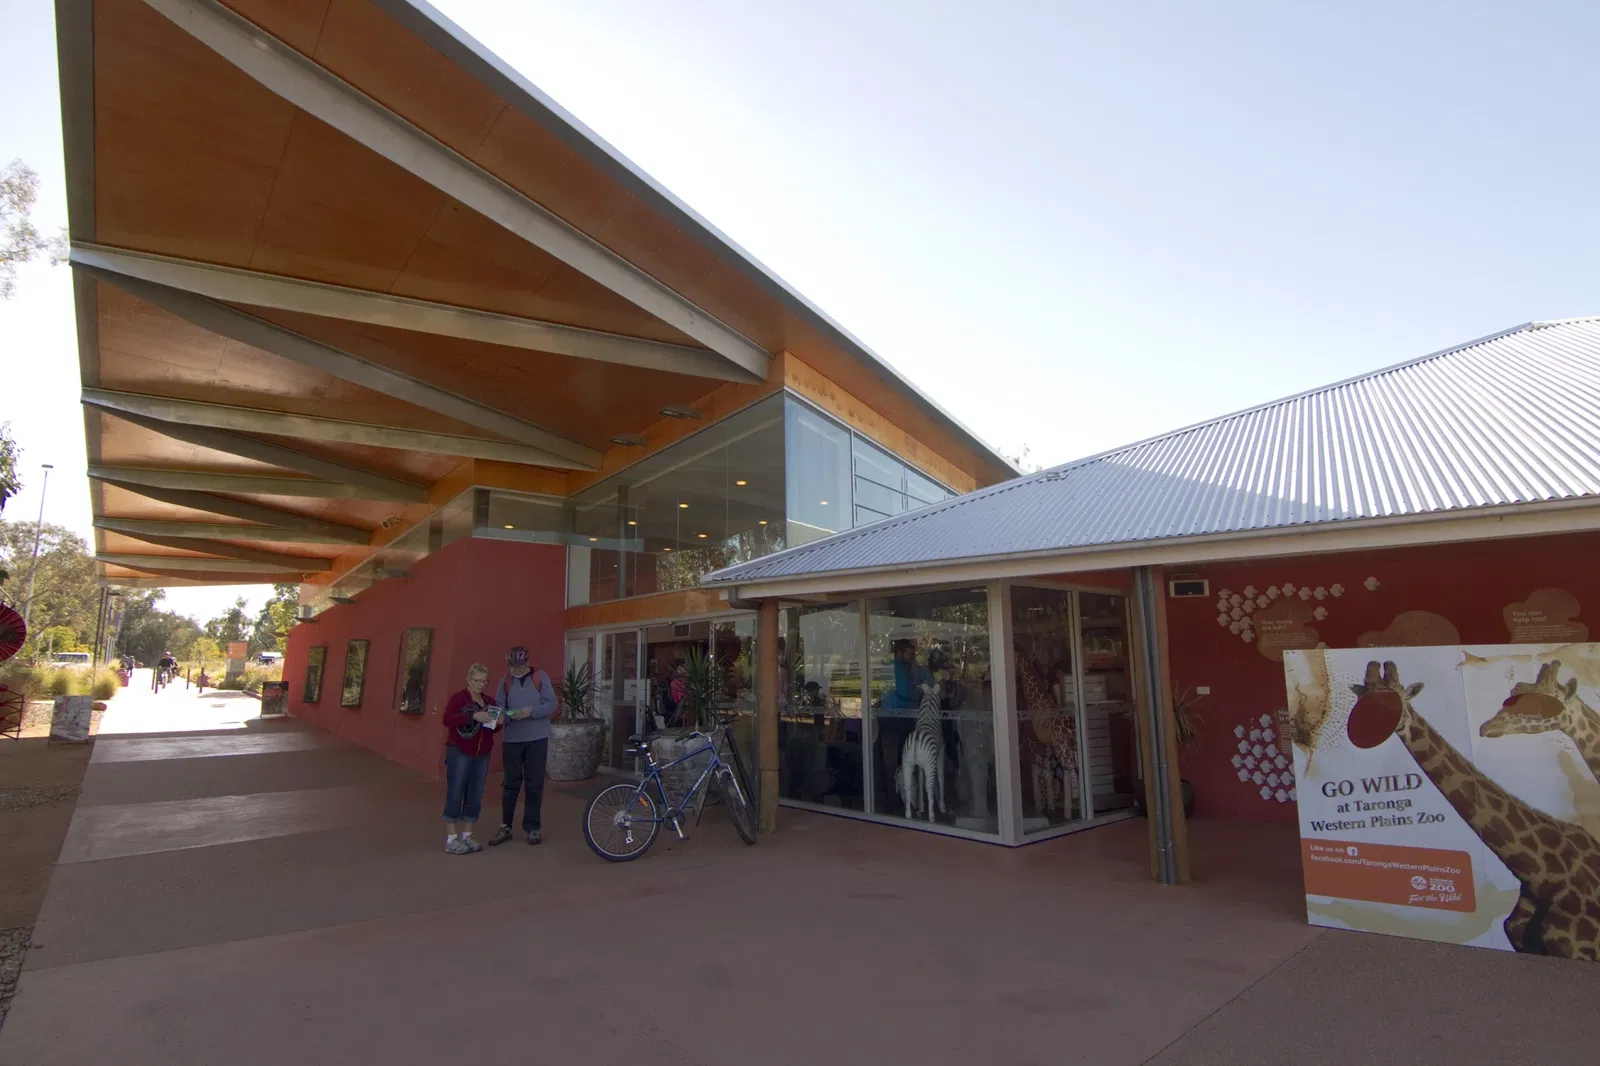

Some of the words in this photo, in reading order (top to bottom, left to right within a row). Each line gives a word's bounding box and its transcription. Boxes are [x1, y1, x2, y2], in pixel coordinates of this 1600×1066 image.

[1321, 779, 1355, 798] GO
[1360, 773, 1423, 794] WILD
[1336, 802, 1350, 814] at
[1353, 798, 1413, 812] Taronga
[1310, 818, 1366, 832] Western
[1370, 814, 1413, 828] Plains
[1417, 812, 1446, 824] Zoo
[1310, 844, 1324, 852] Like
[1310, 854, 1461, 875] facebook.com/TarongaWesternPlainsZoo
